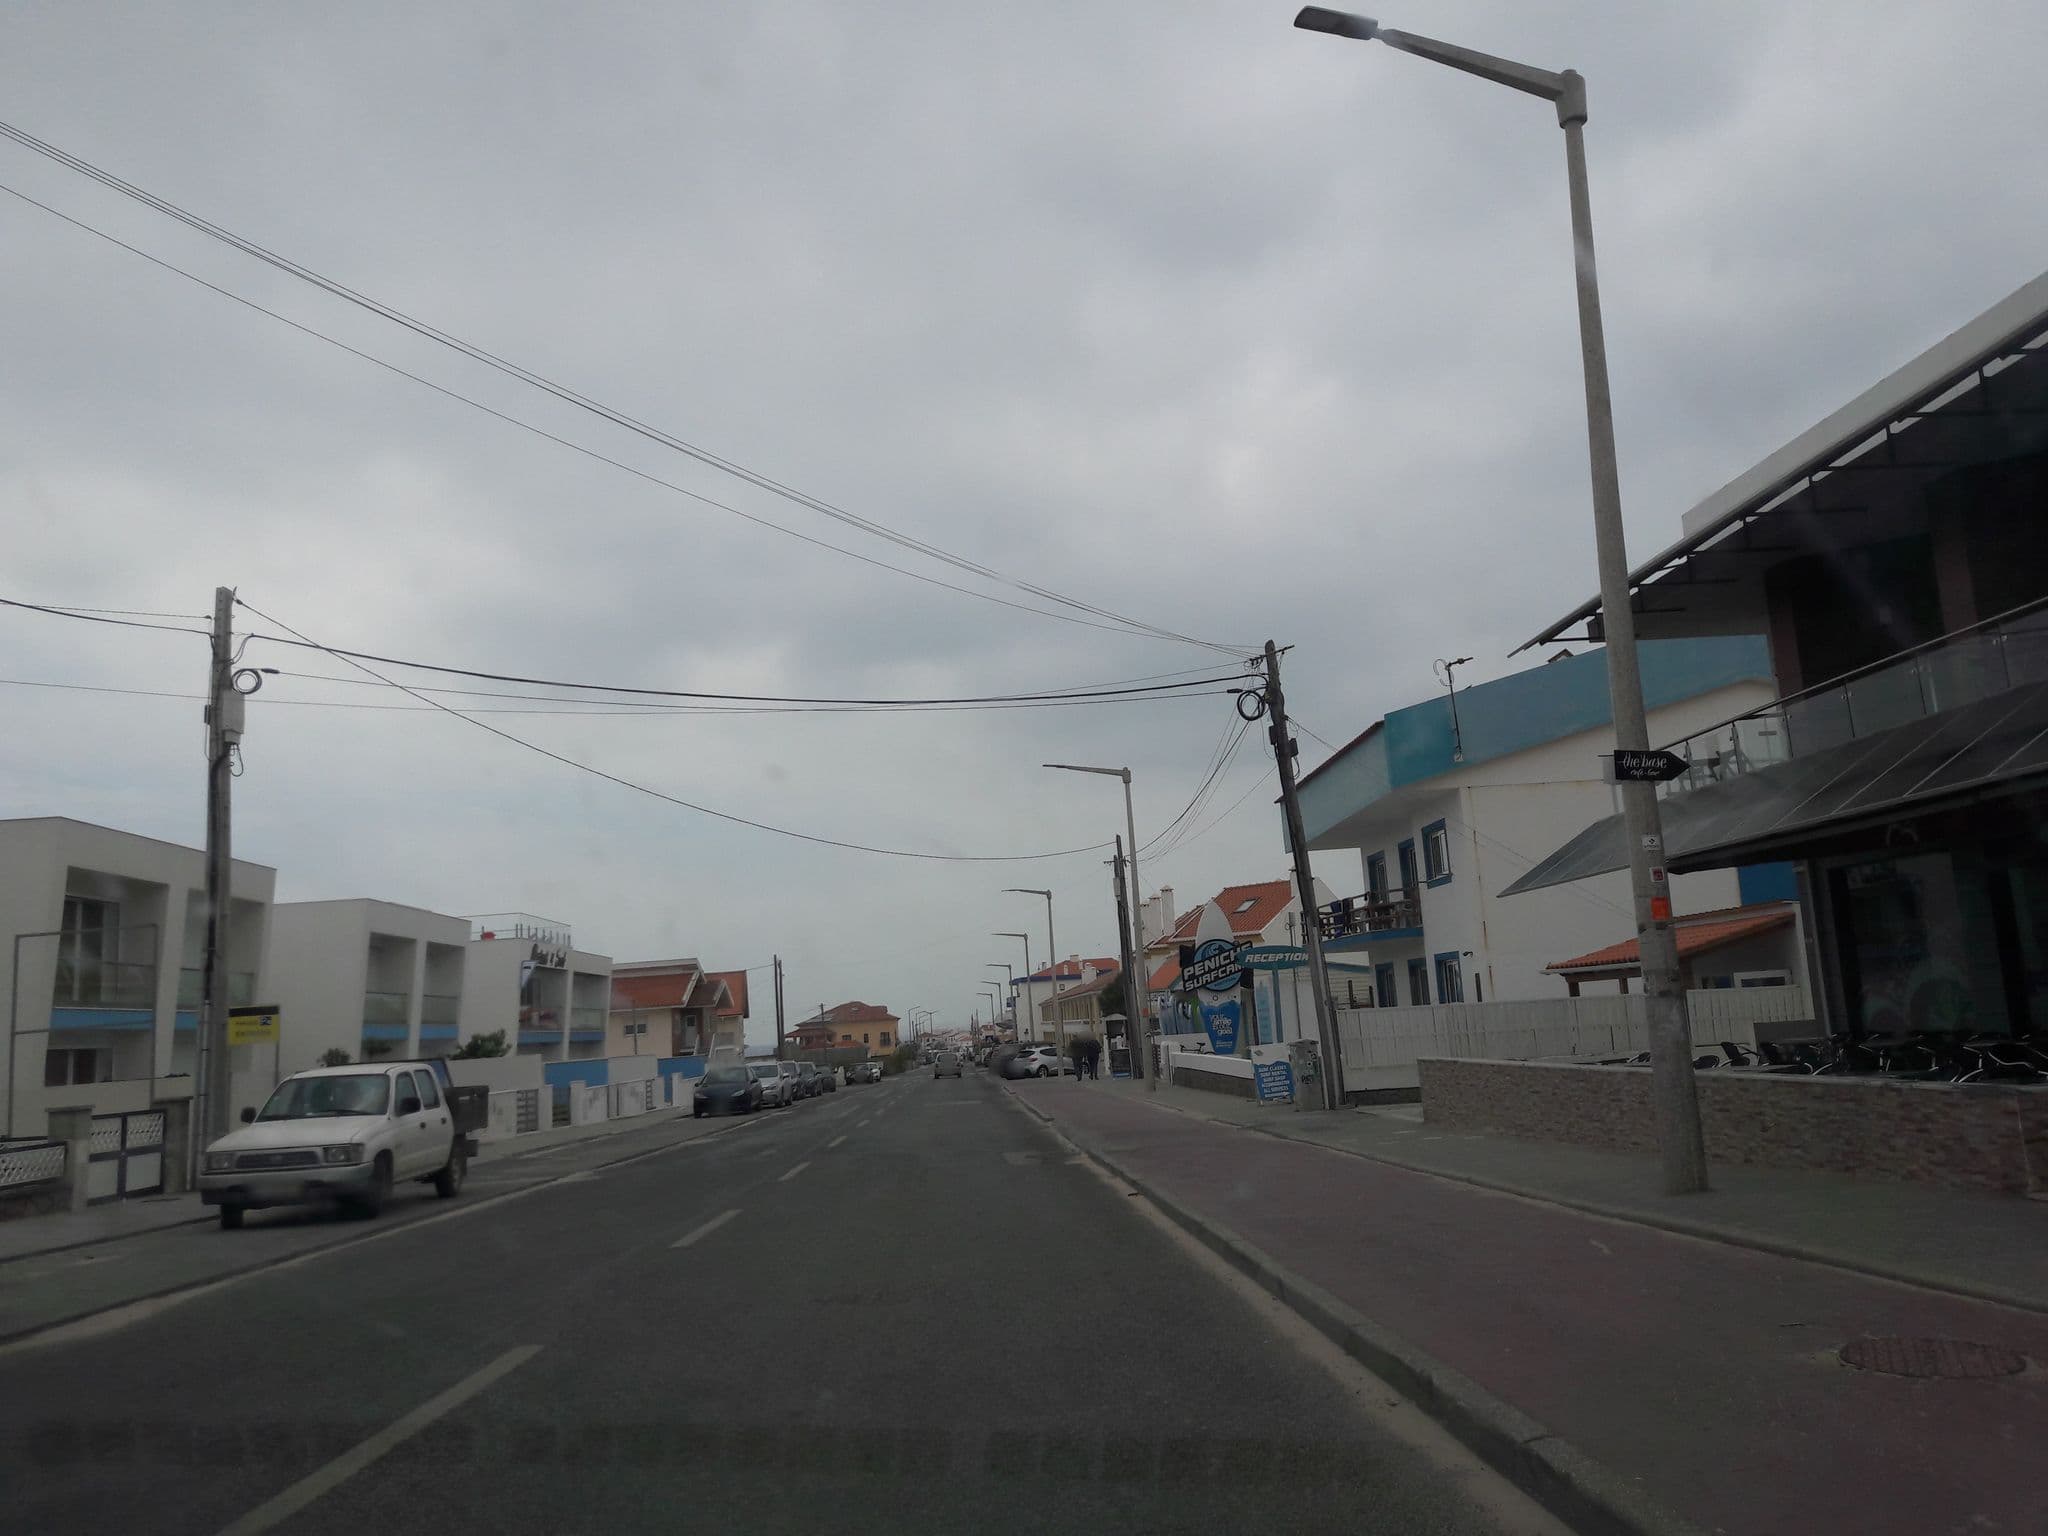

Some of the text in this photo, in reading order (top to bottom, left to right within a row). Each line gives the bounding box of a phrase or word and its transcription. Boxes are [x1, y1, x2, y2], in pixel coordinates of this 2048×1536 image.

[1623, 751, 1667, 769] the base
[1245, 952, 1309, 963] RECEPTION
